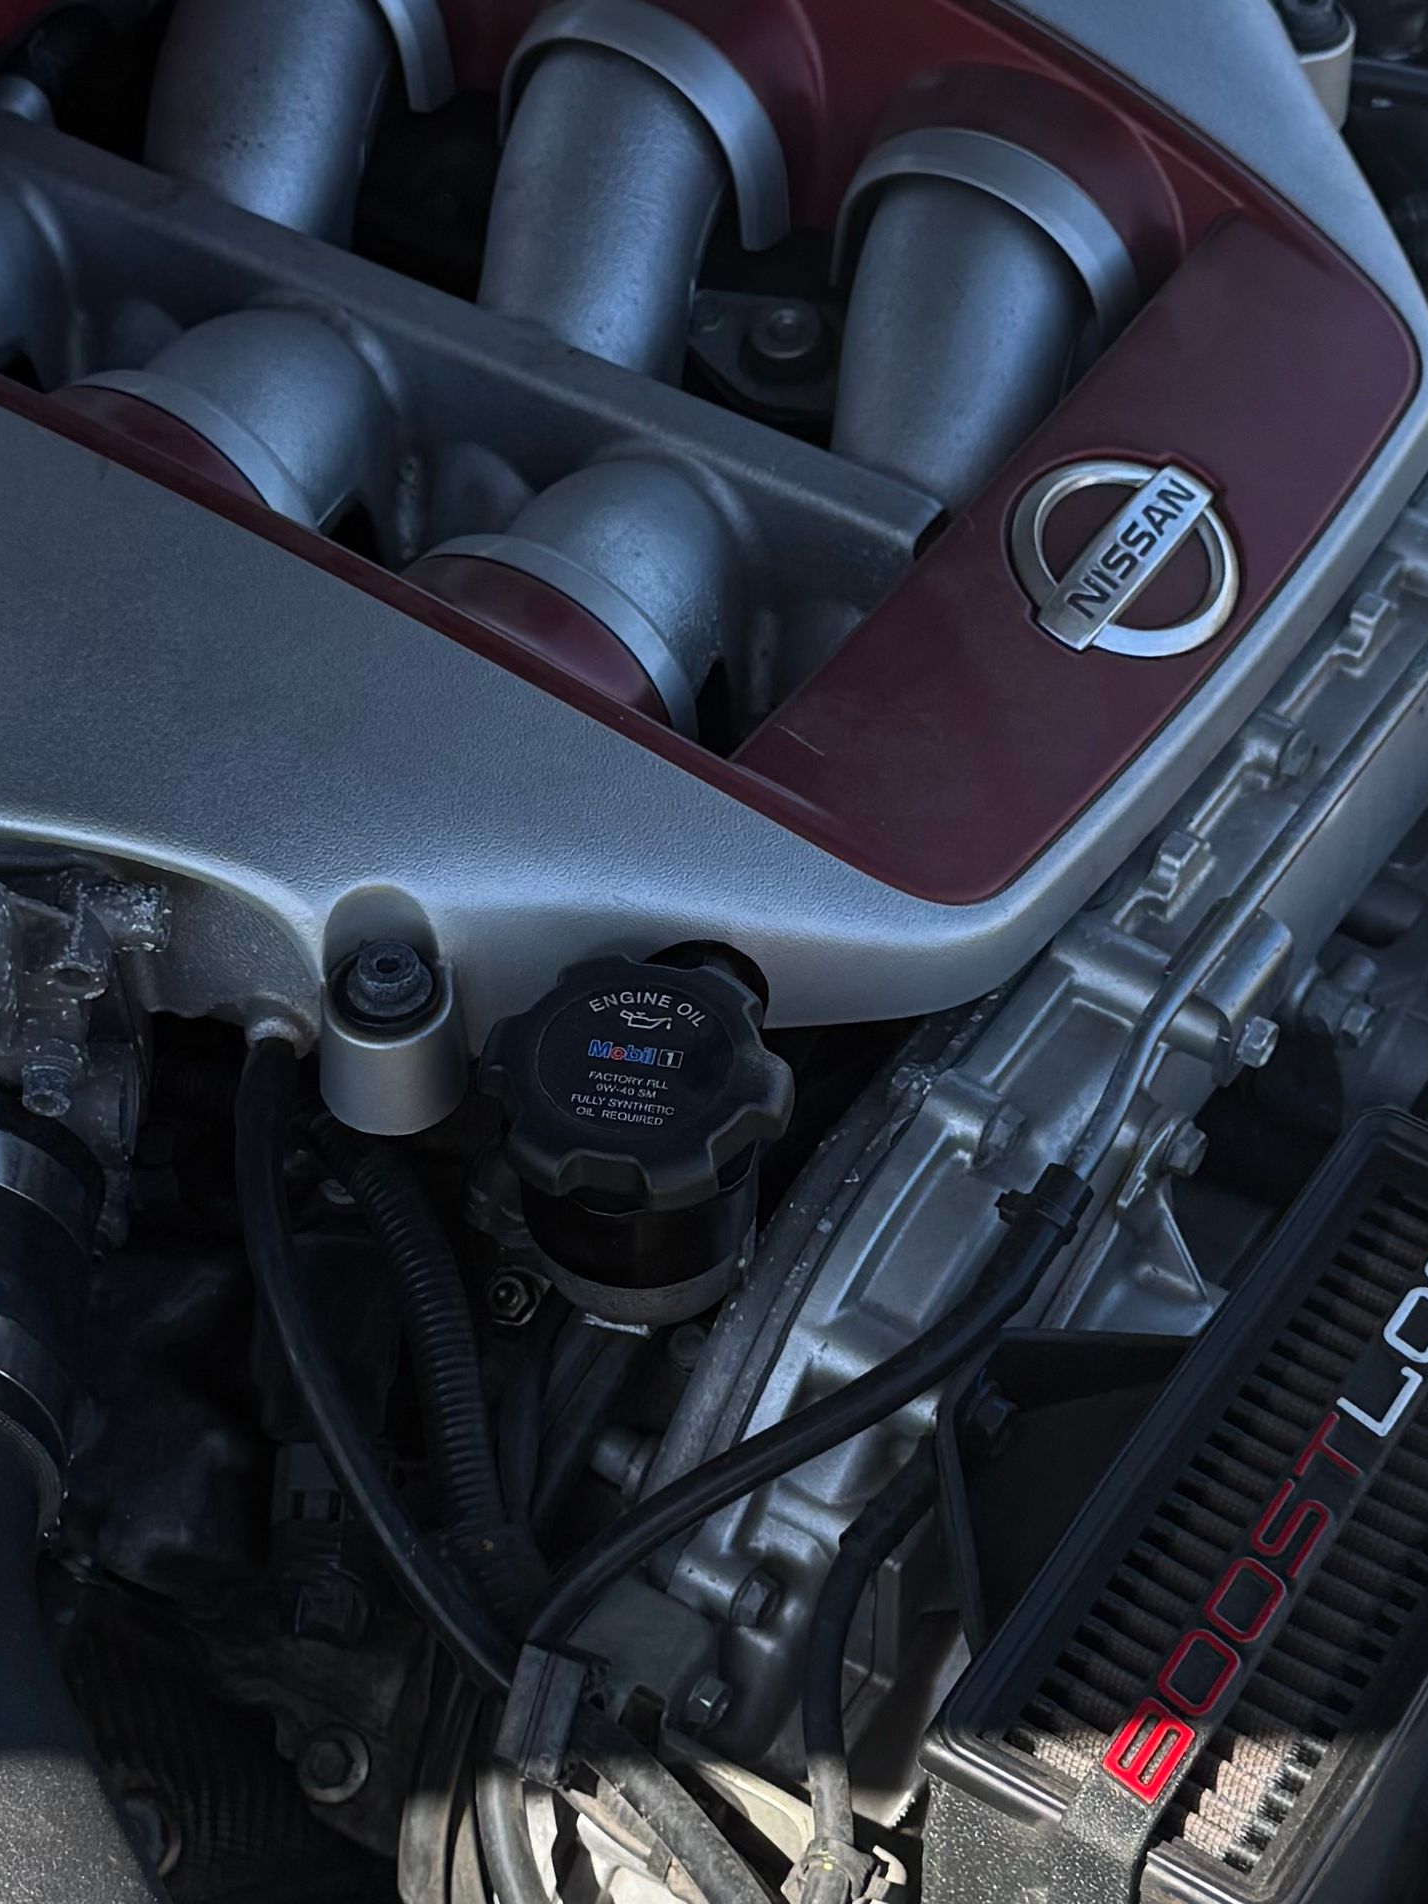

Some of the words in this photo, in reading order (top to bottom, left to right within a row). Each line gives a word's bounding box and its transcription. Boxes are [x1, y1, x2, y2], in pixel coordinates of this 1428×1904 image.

[1066, 477, 1197, 619] NISSAN
[589, 991, 673, 1013] ENGINE
[677, 1003, 706, 1028] OIL
[588, 1039, 657, 1065] Mobil
[588, 1071, 644, 1086] FACTORY
[646, 1079, 669, 1090] FILL
[596, 1083, 635, 1096] 0W-40
[638, 1088, 657, 1099] SM
[571, 1093, 606, 1105] FULLY
[607, 1098, 675, 1116] SYNTHETIC
[575, 1106, 595, 1117] OIL
[601, 1109, 664, 1127] REQUIRED
